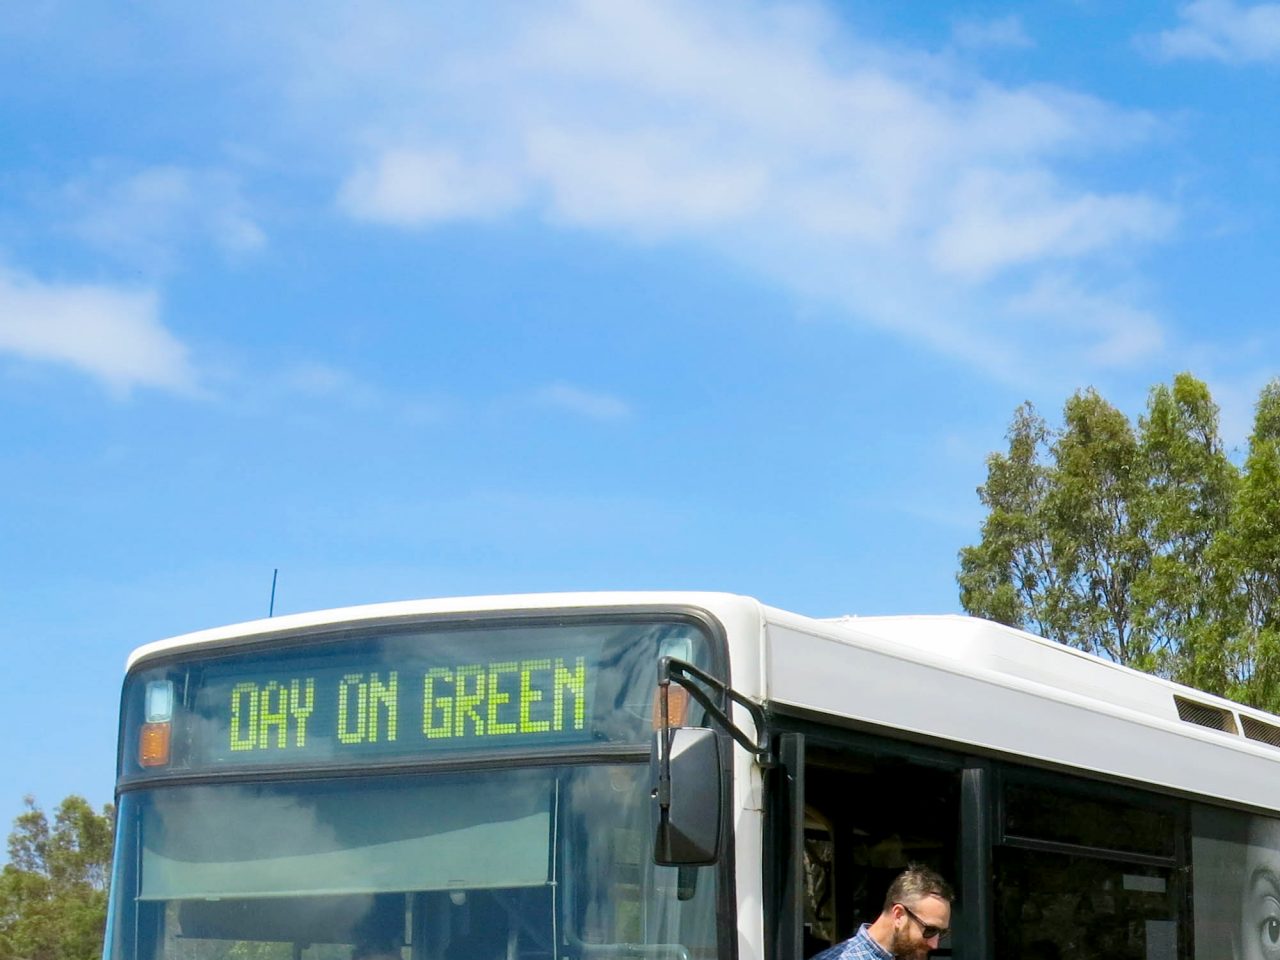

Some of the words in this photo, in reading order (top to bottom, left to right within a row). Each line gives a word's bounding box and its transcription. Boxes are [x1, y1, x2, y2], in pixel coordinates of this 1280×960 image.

[229, 677, 315, 751] DAY
[338, 670, 399, 744] ON
[422, 656, 585, 739] GREEN
